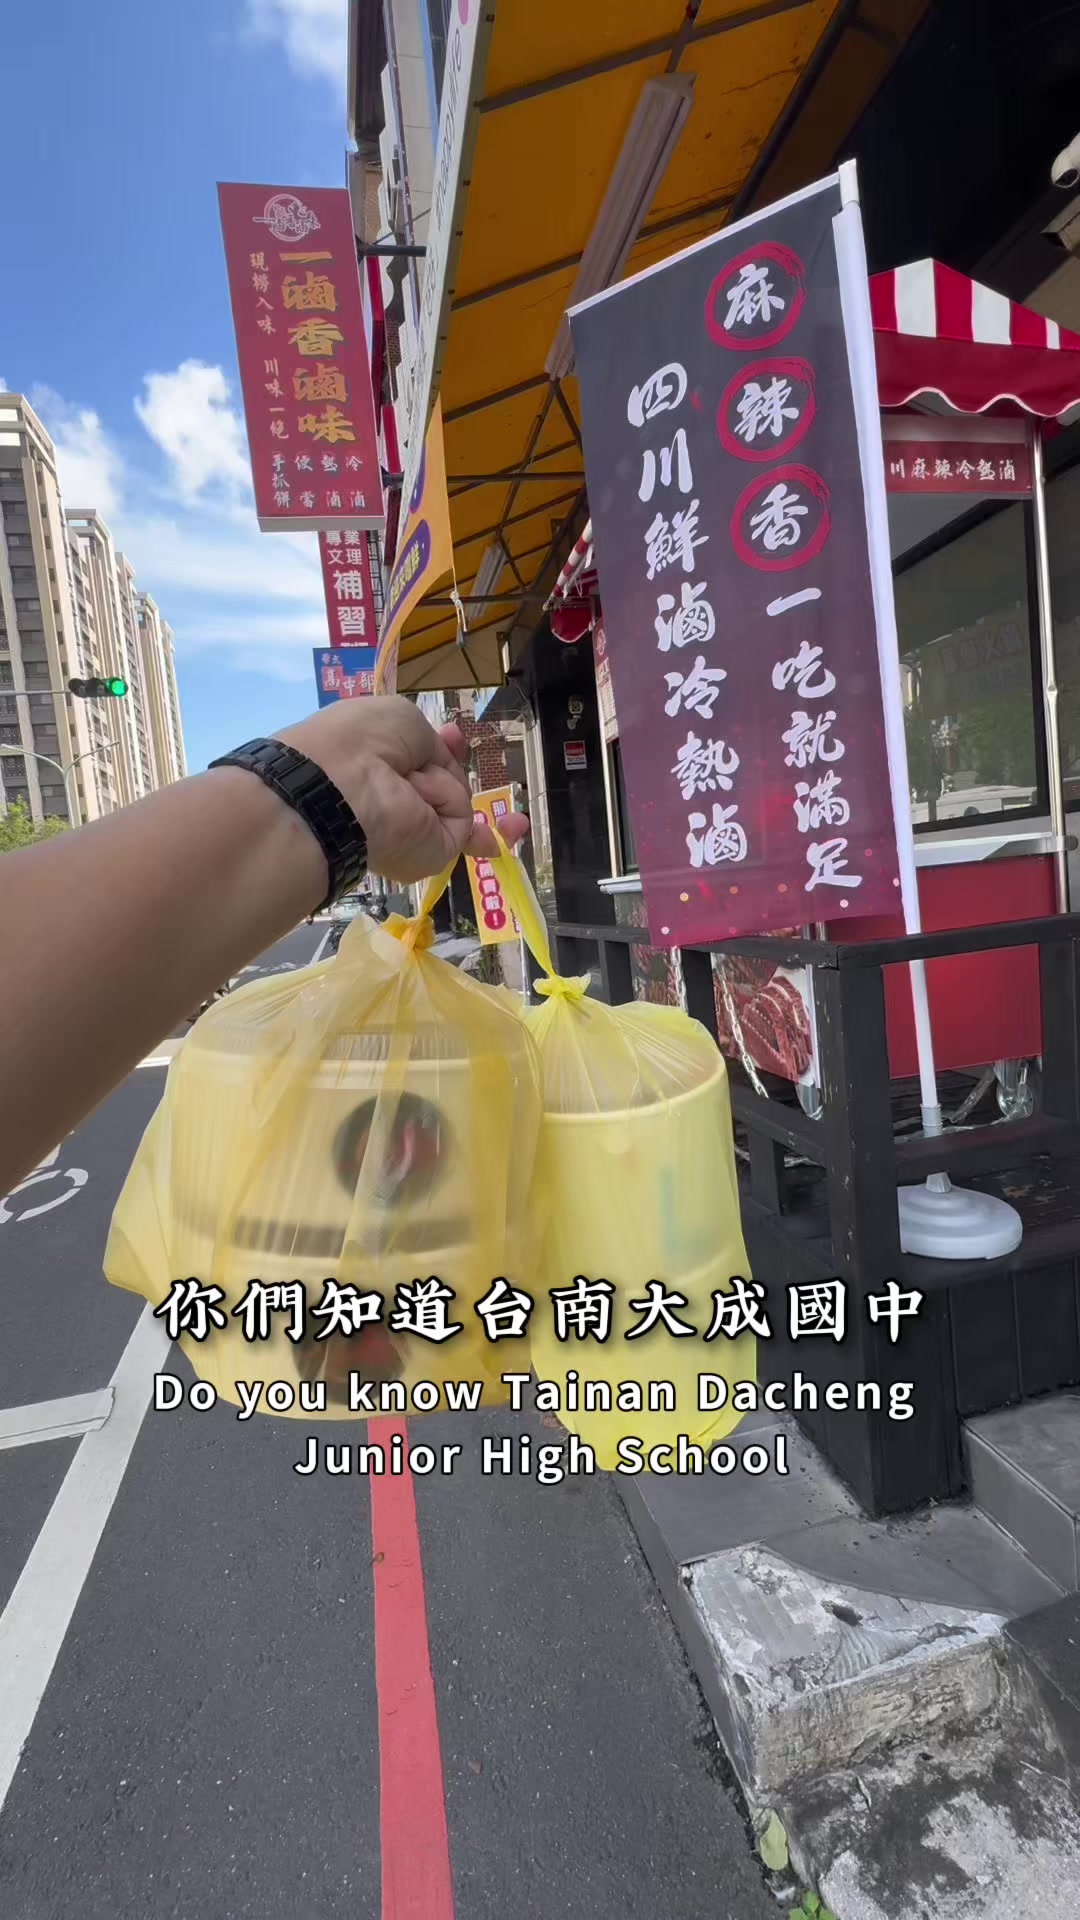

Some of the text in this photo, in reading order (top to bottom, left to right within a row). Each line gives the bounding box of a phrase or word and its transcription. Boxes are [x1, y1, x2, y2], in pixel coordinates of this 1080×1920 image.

[279, 251, 355, 443] 一滷香滷味
[327, 549, 363, 565] 文理
[332, 570, 369, 647] 補習
[627, 362, 747, 868] 四川鮮滷冷熱滷
